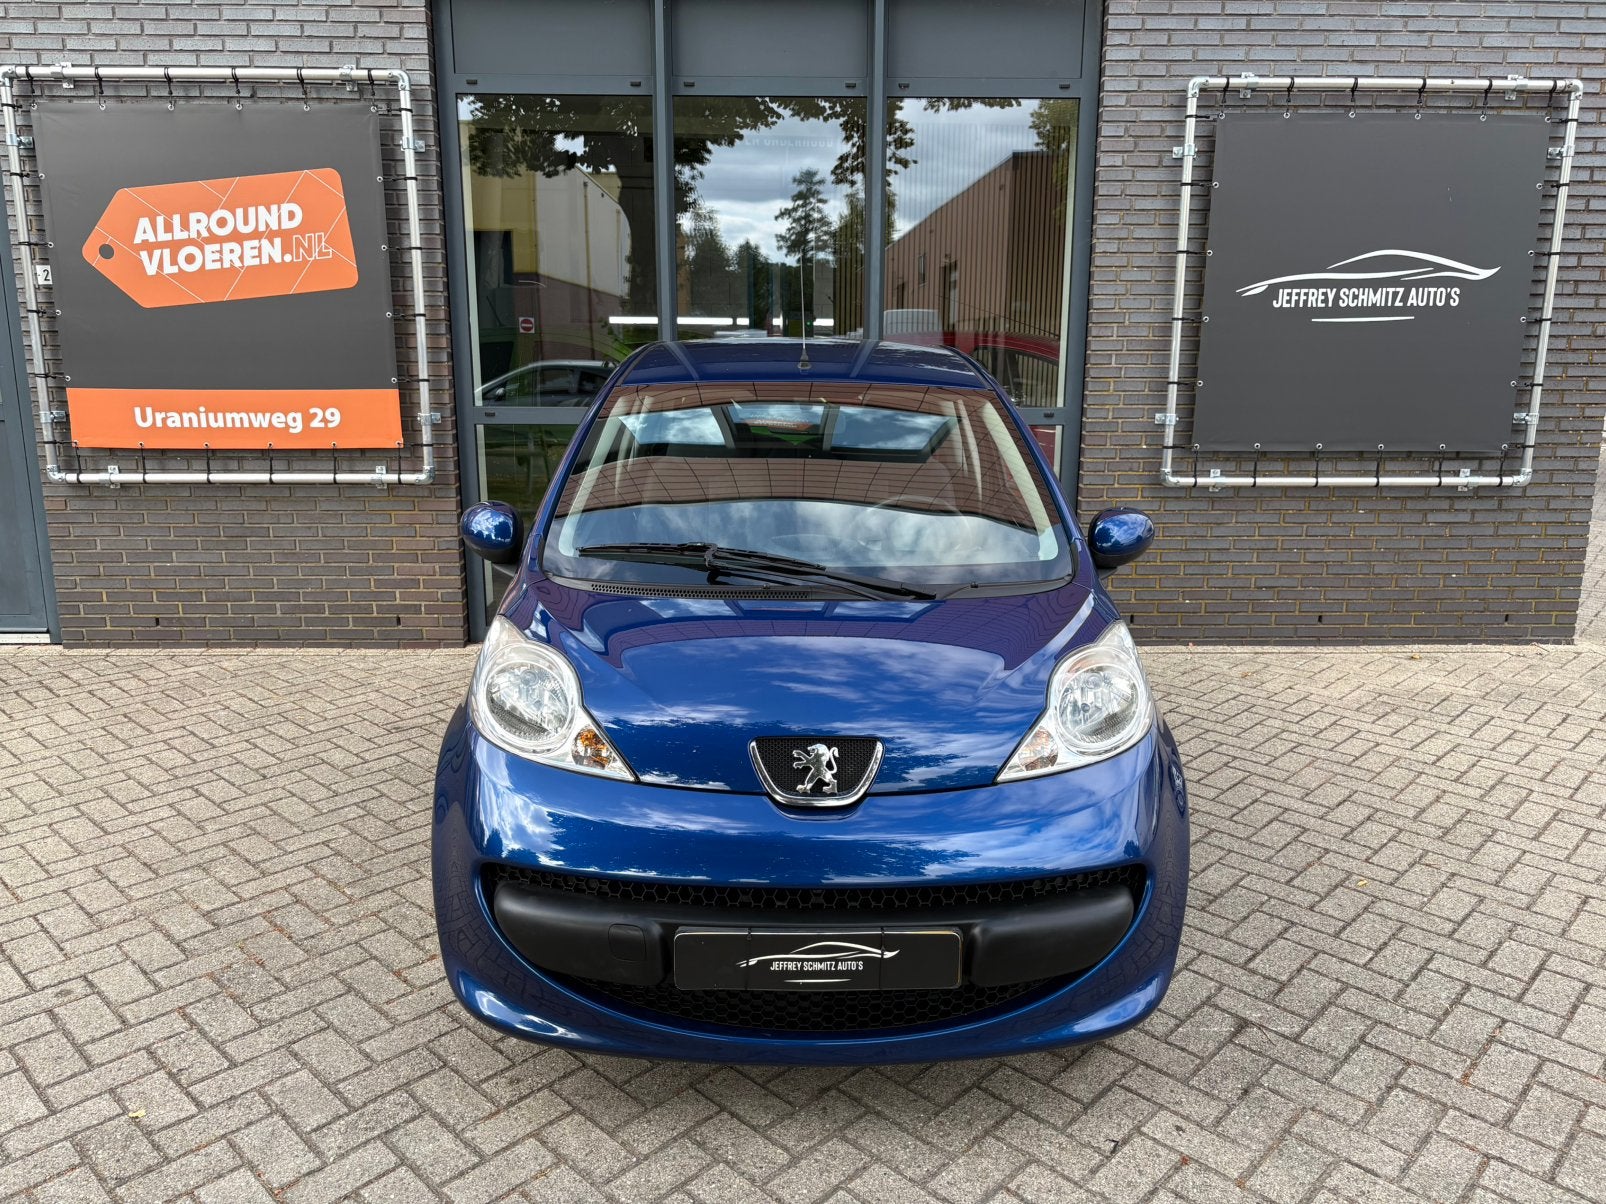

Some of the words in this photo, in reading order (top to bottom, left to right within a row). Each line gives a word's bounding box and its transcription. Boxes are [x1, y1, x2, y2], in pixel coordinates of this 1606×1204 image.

[133, 202, 303, 244] ALLROUND
[139, 232, 333, 276] VLOEREN.NL
[1272, 288, 1337, 308] JEFFREY
[1338, 287, 1405, 307] SCHMITZ
[1406, 287, 1461, 307] AUTO'S
[133, 406, 303, 434] Uraniumweg
[308, 407, 341, 428] 29
[770, 961, 802, 971] JEFFREY
[803, 961, 836, 971] SCHMITZ
[837, 960, 864, 971] AUTO'S
